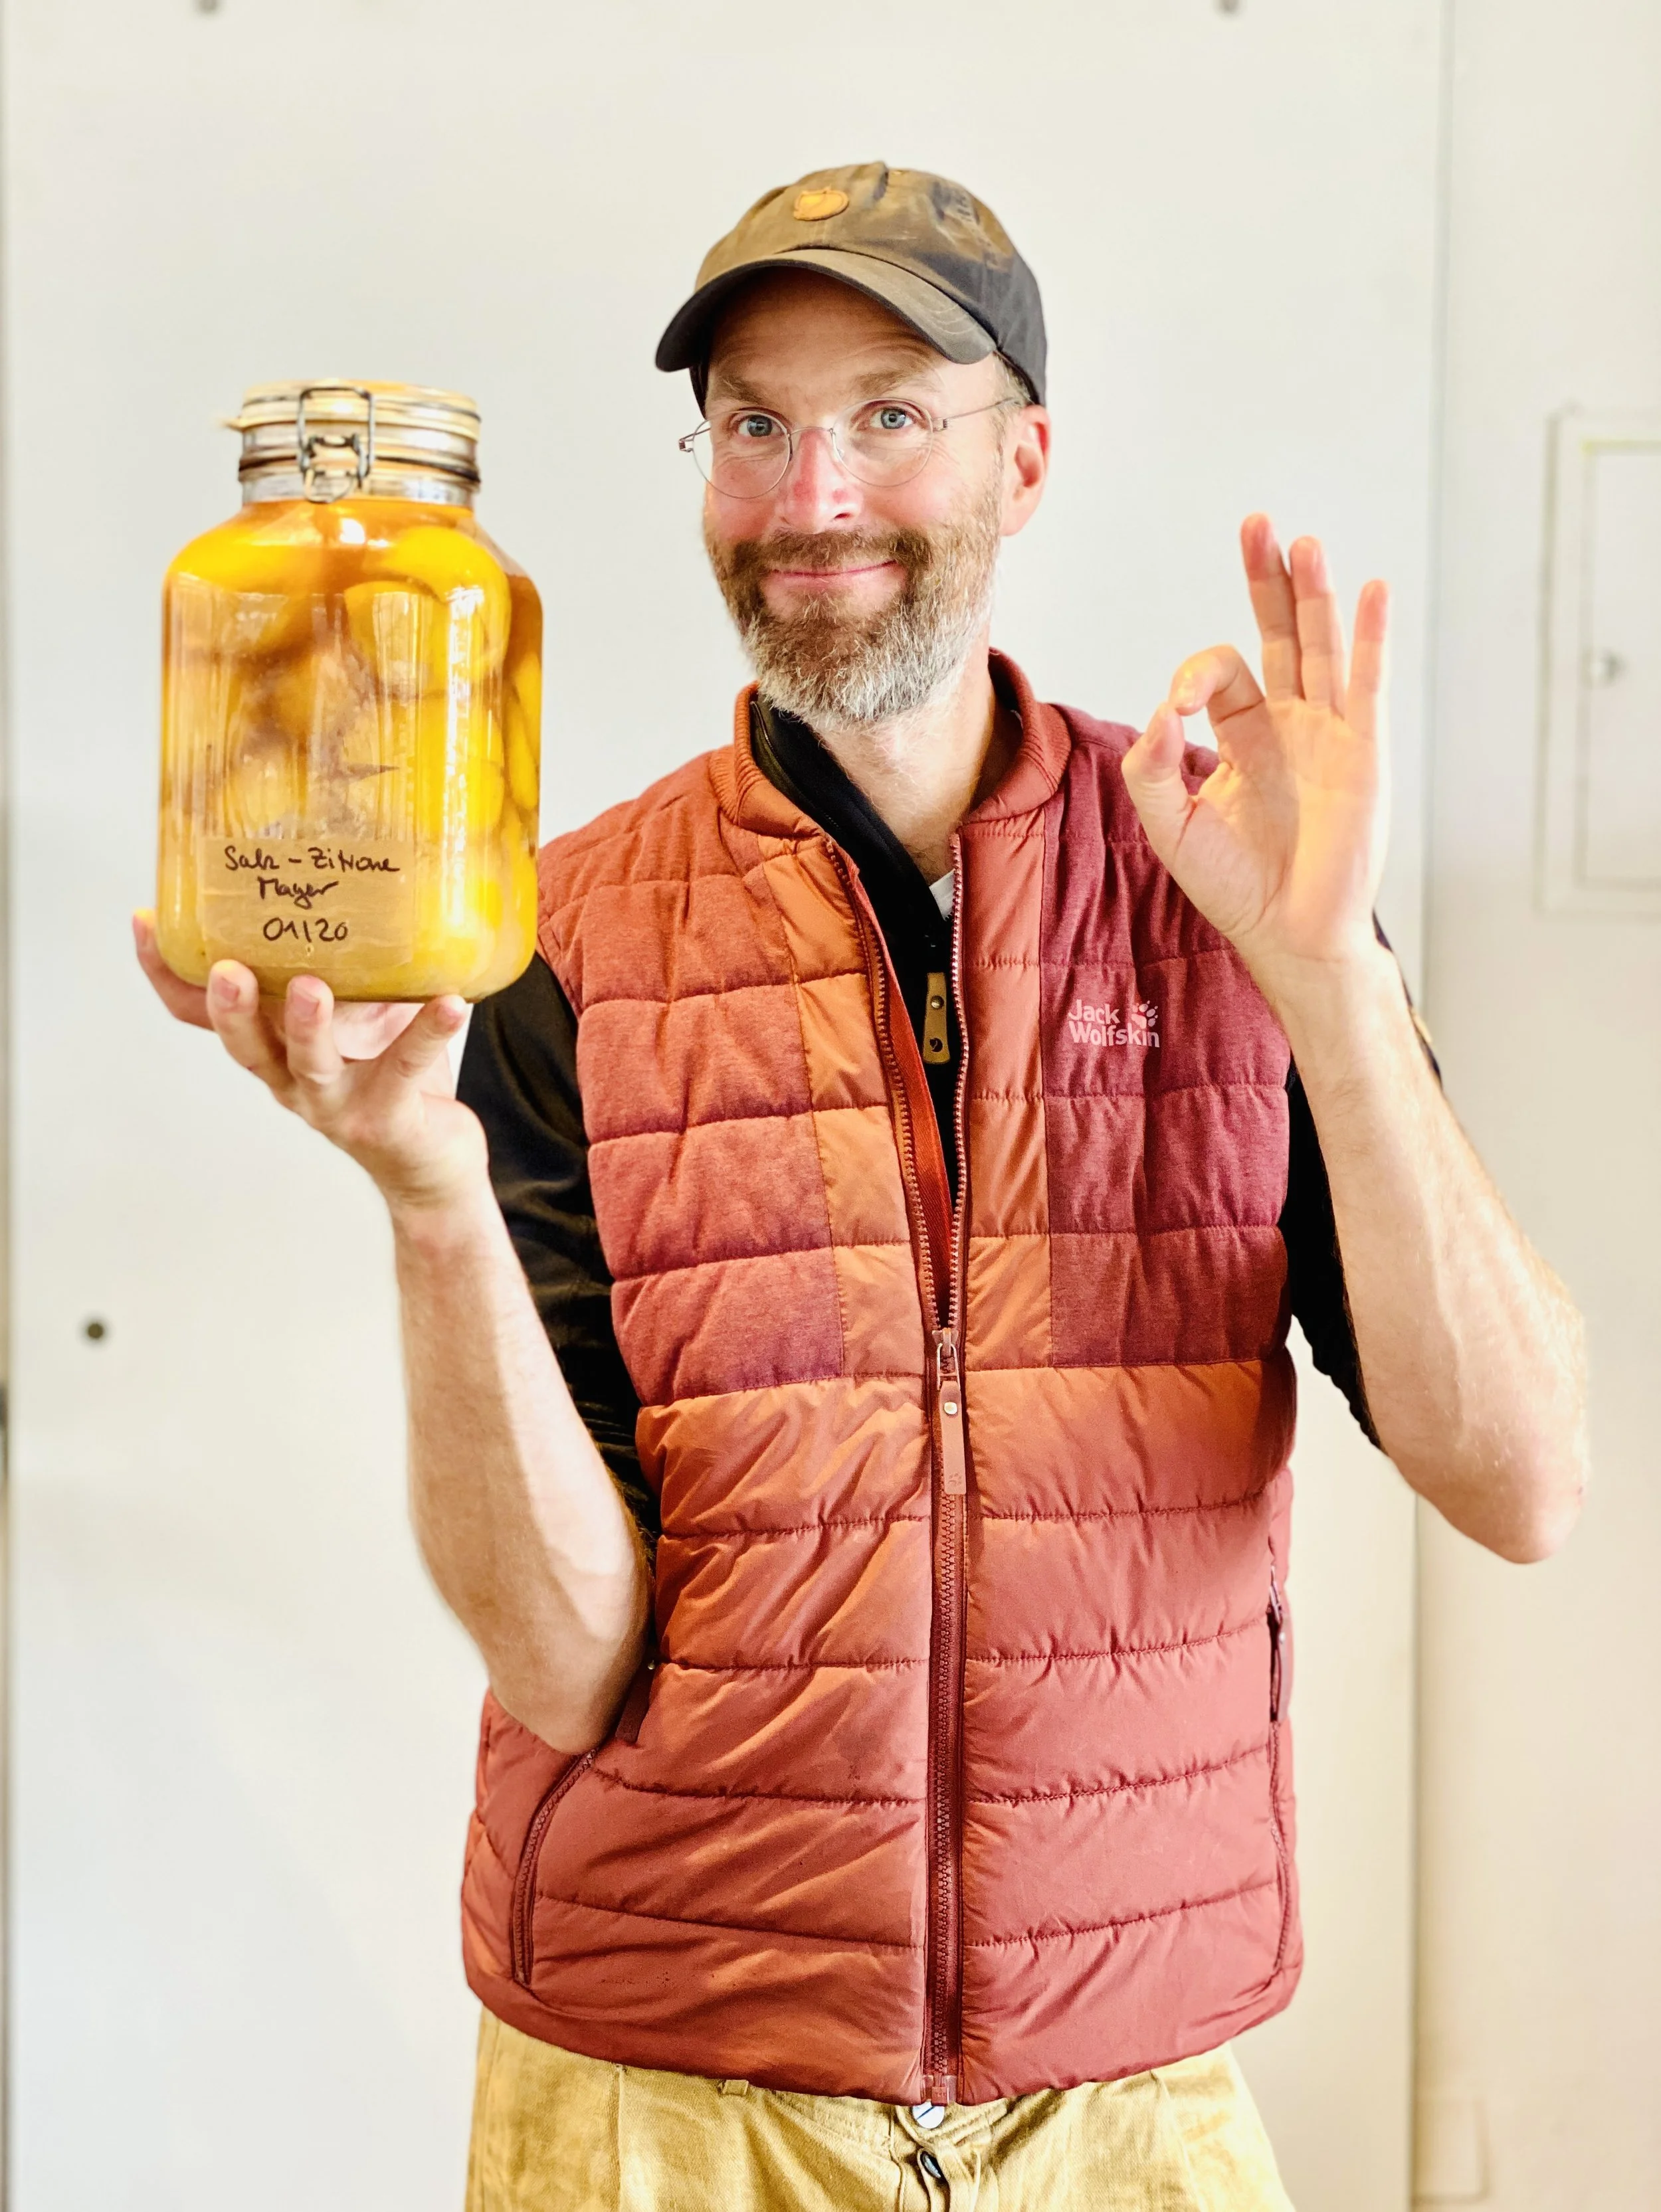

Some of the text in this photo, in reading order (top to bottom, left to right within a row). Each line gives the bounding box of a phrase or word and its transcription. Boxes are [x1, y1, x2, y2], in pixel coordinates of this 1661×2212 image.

[308, 846, 401, 874] Zitrone
[1068, 998, 1121, 1024] Jack
[1068, 1020, 1160, 1048] Wolfskin
